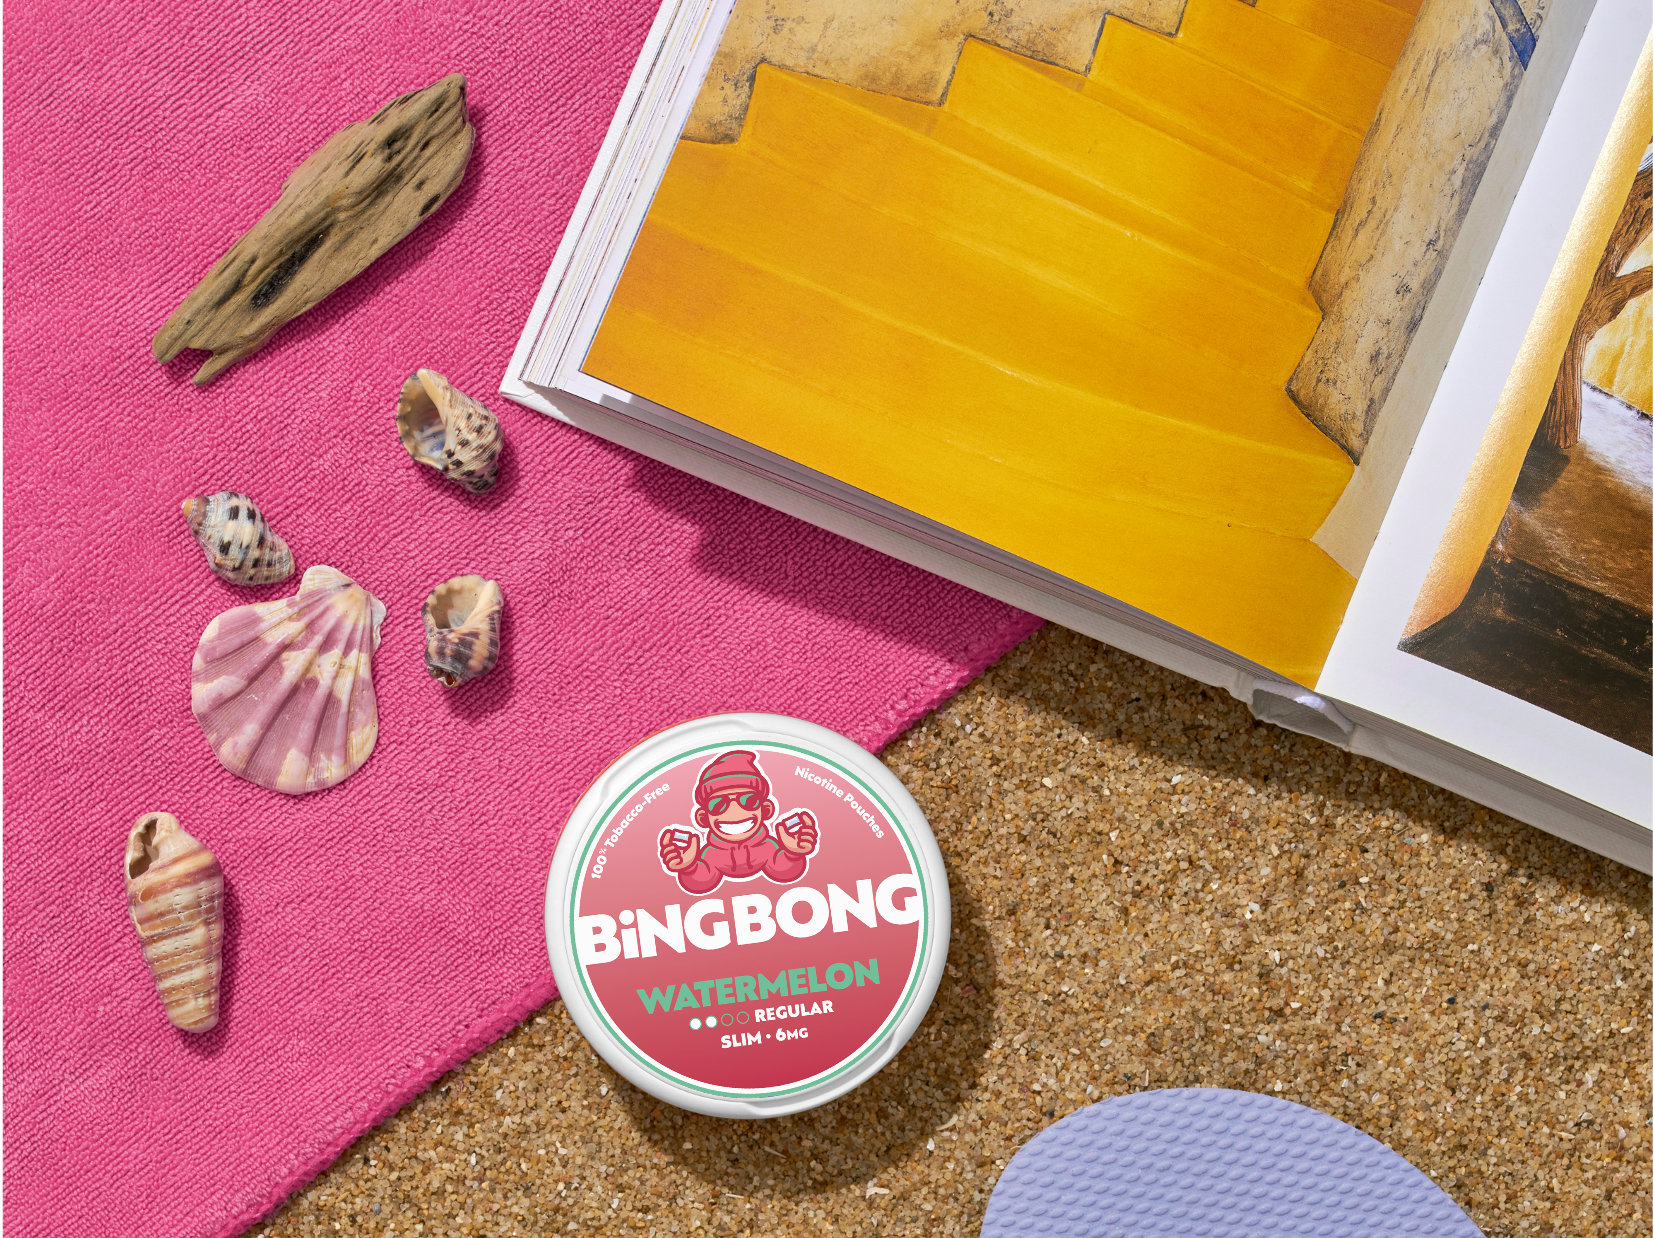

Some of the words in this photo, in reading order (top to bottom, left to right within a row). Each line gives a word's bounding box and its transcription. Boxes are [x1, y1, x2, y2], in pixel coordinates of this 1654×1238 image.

[794, 765, 844, 797] Nicotine
[843, 793, 885, 839] Pouches
[591, 848, 607, 879] 100%
[604, 783, 671, 847] Tobacco-Free
[636, 958, 880, 1015] WATERMELON
[754, 1000, 834, 1023] REGULAR
[720, 1031, 762, 1049] SLIM
